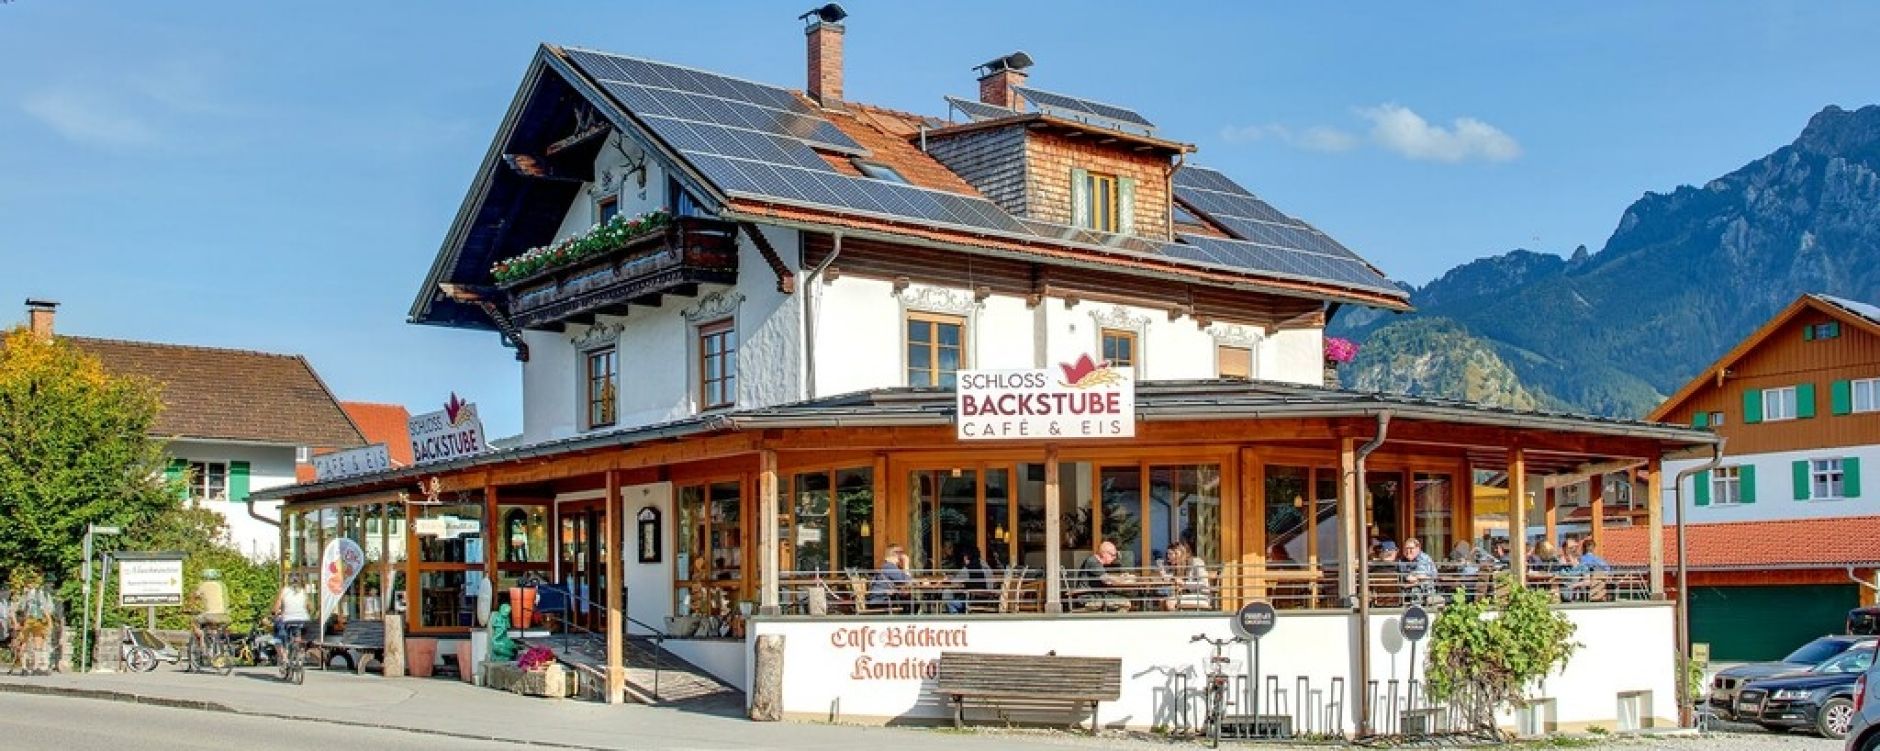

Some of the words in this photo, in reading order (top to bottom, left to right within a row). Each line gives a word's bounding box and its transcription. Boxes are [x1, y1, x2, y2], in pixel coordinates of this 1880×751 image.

[962, 373, 1045, 389] SCHLOSS
[962, 392, 1121, 415] BACKSTUBE
[410, 416, 443, 436] SCHLOSS
[1049, 420, 1061, 436] &
[1081, 420, 1121, 434] EIS
[413, 429, 479, 461] BACKSTUBE
[366, 449, 386, 469] EIS
[831, 625, 876, 652] Cafe
[884, 624, 968, 647] Bäckerei
[850, 655, 938, 680] Kondito
